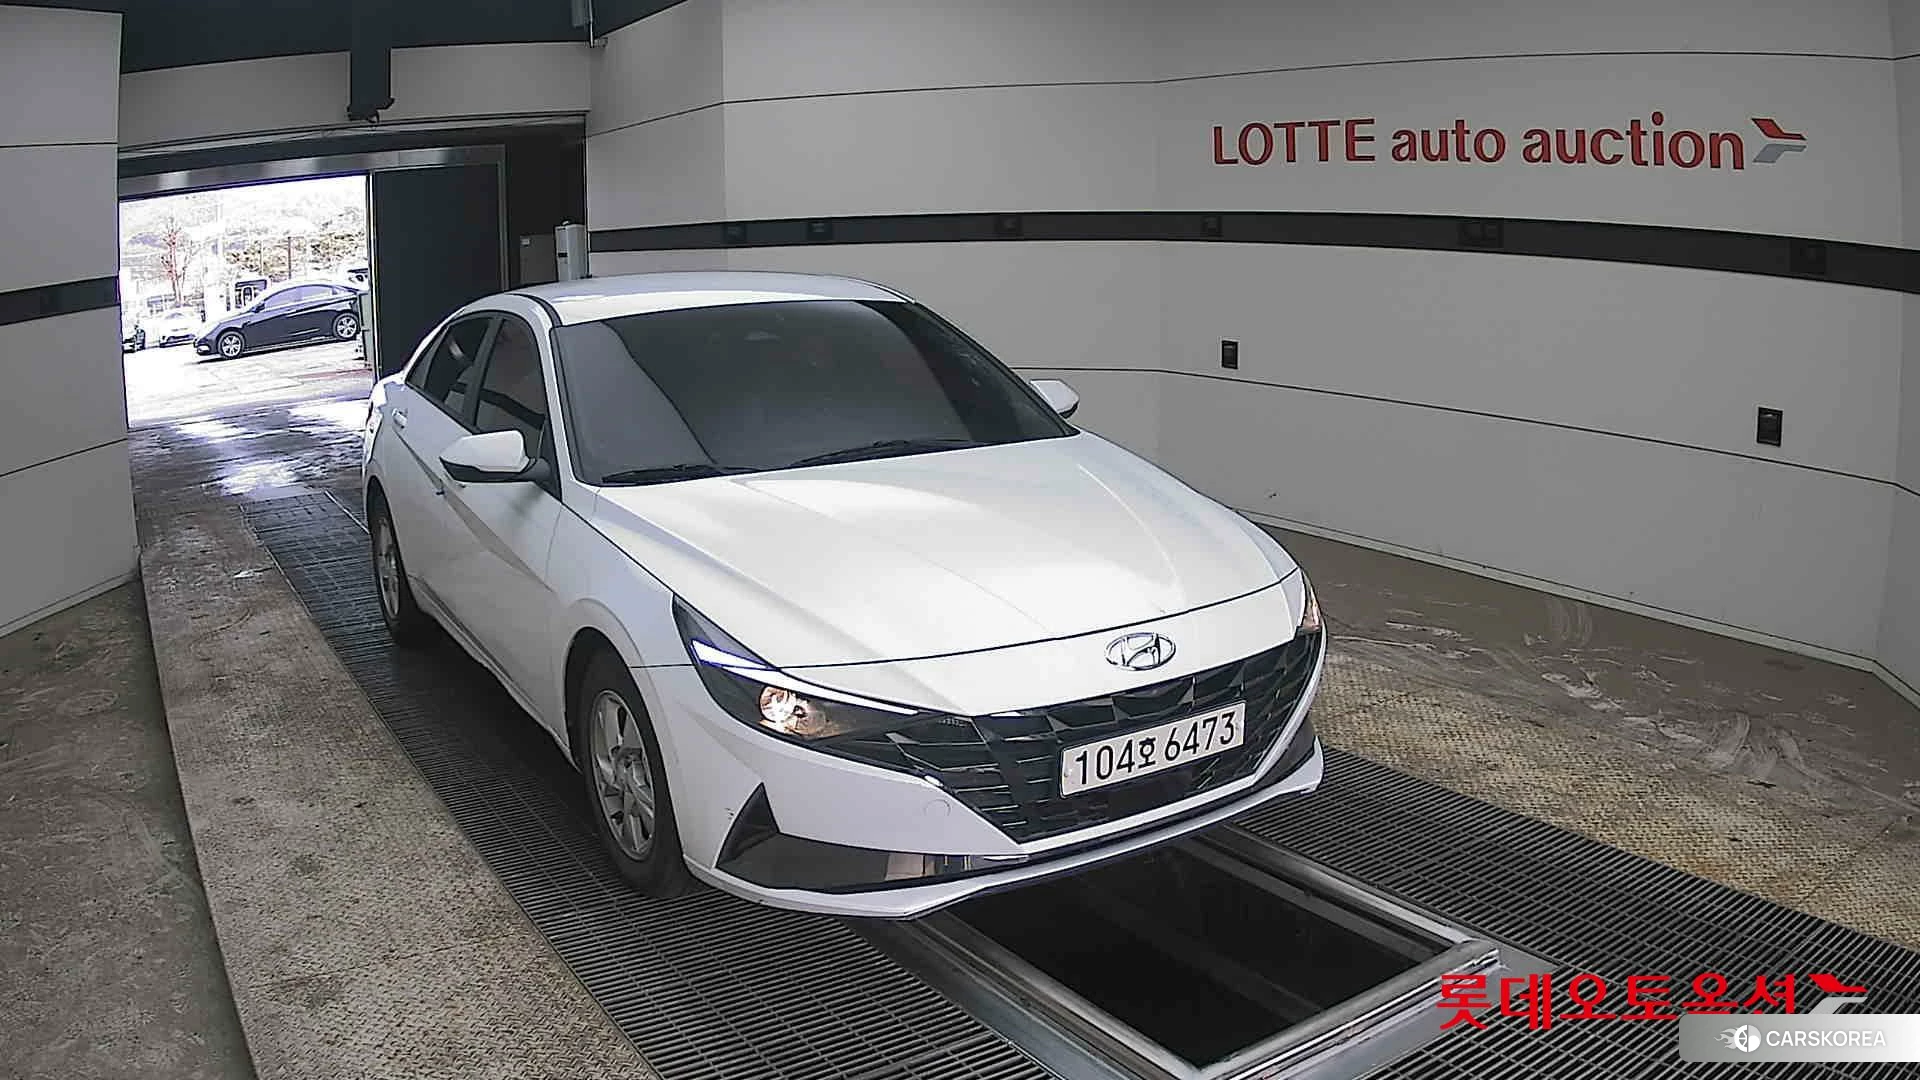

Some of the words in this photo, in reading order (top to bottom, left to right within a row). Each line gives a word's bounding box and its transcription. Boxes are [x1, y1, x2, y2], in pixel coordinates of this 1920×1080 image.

[1212, 118, 1376, 165] LOTTE
[1391, 119, 1507, 163] auto
[1521, 111, 1745, 170] auction
[1164, 711, 1236, 762] 6473
